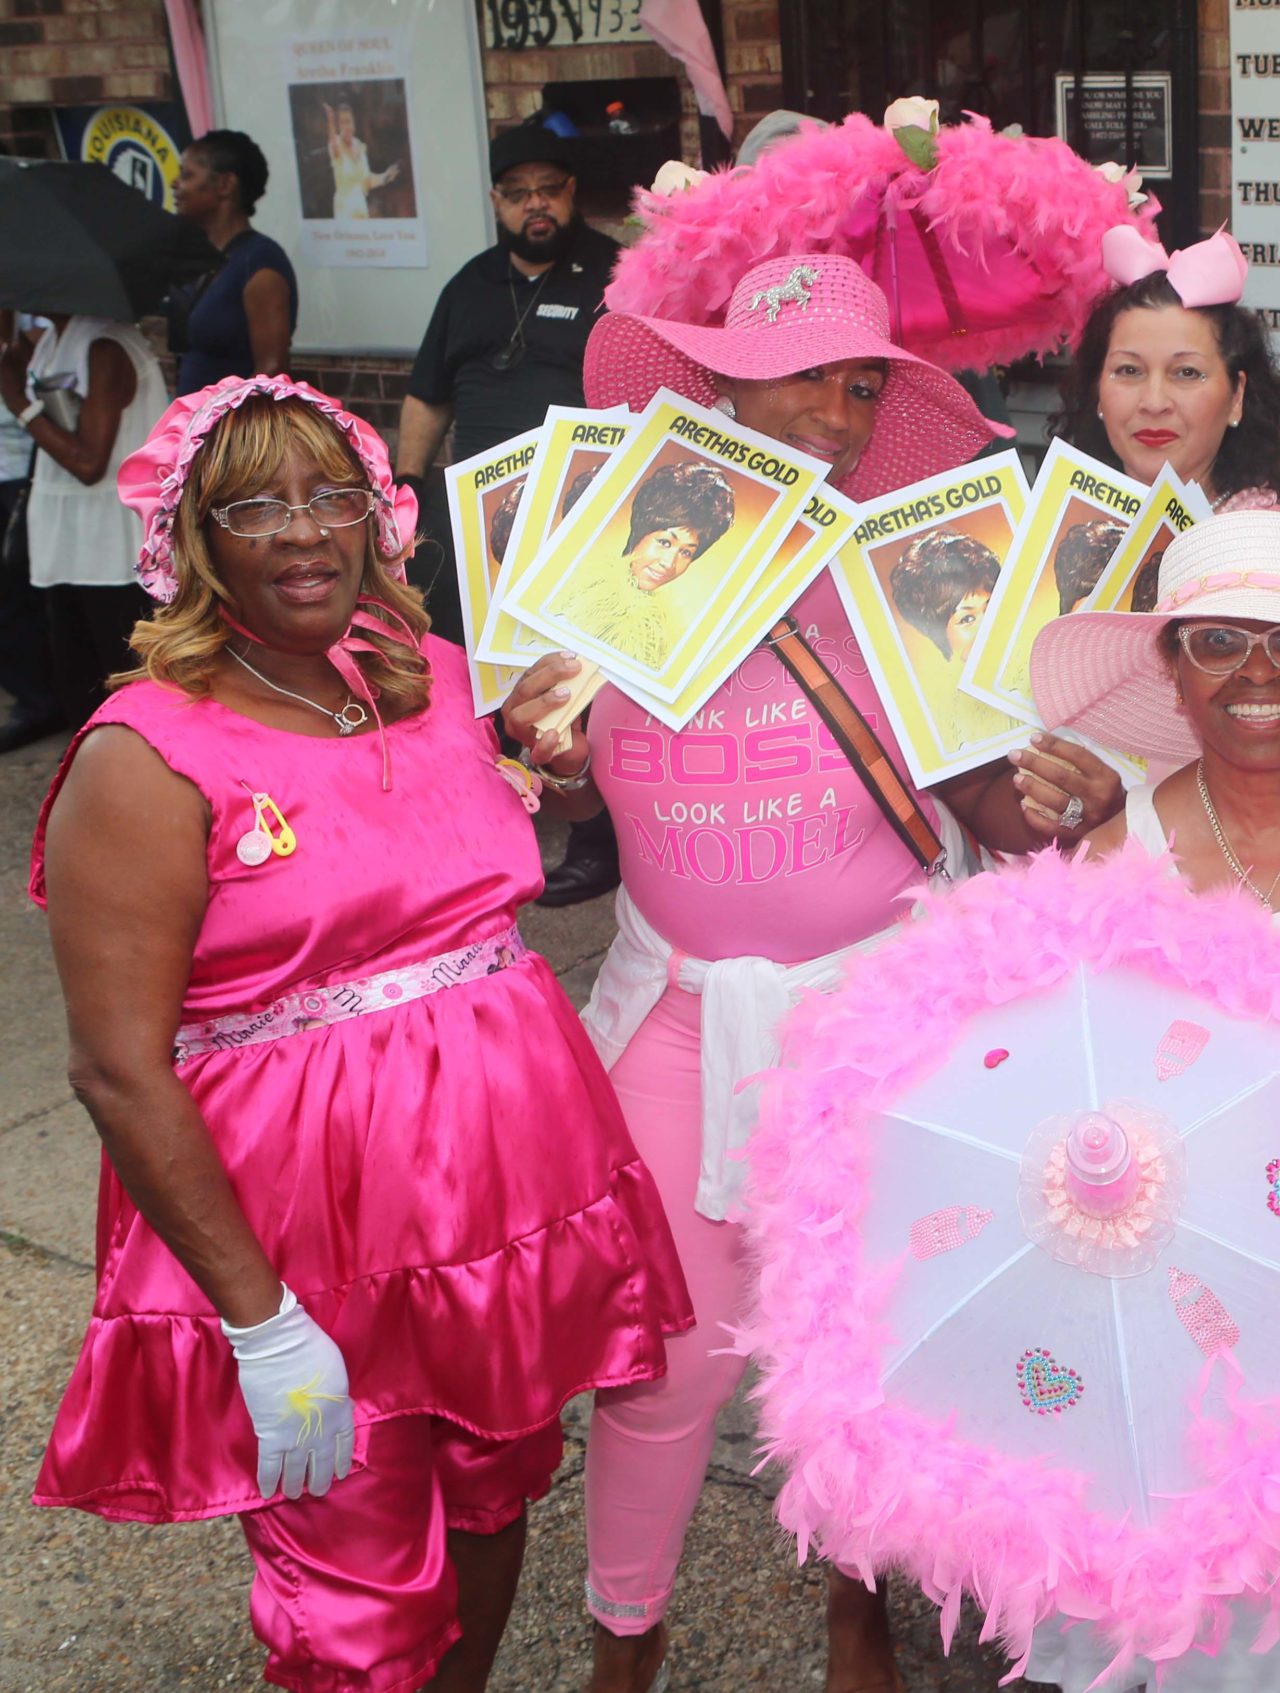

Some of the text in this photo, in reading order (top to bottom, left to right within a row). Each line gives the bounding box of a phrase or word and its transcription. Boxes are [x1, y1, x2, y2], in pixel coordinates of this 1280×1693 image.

[669, 415, 800, 486] ARETHA'S GOLD
[803, 496, 837, 527] OLD
[854, 475, 1002, 545] ARETHA'S GOLD
[745, 698, 808, 728] LIKE
[654, 787, 838, 825] LOOK LIKE A
[624, 805, 866, 886] MODEL
[211, 1011, 275, 1050] Minnie
